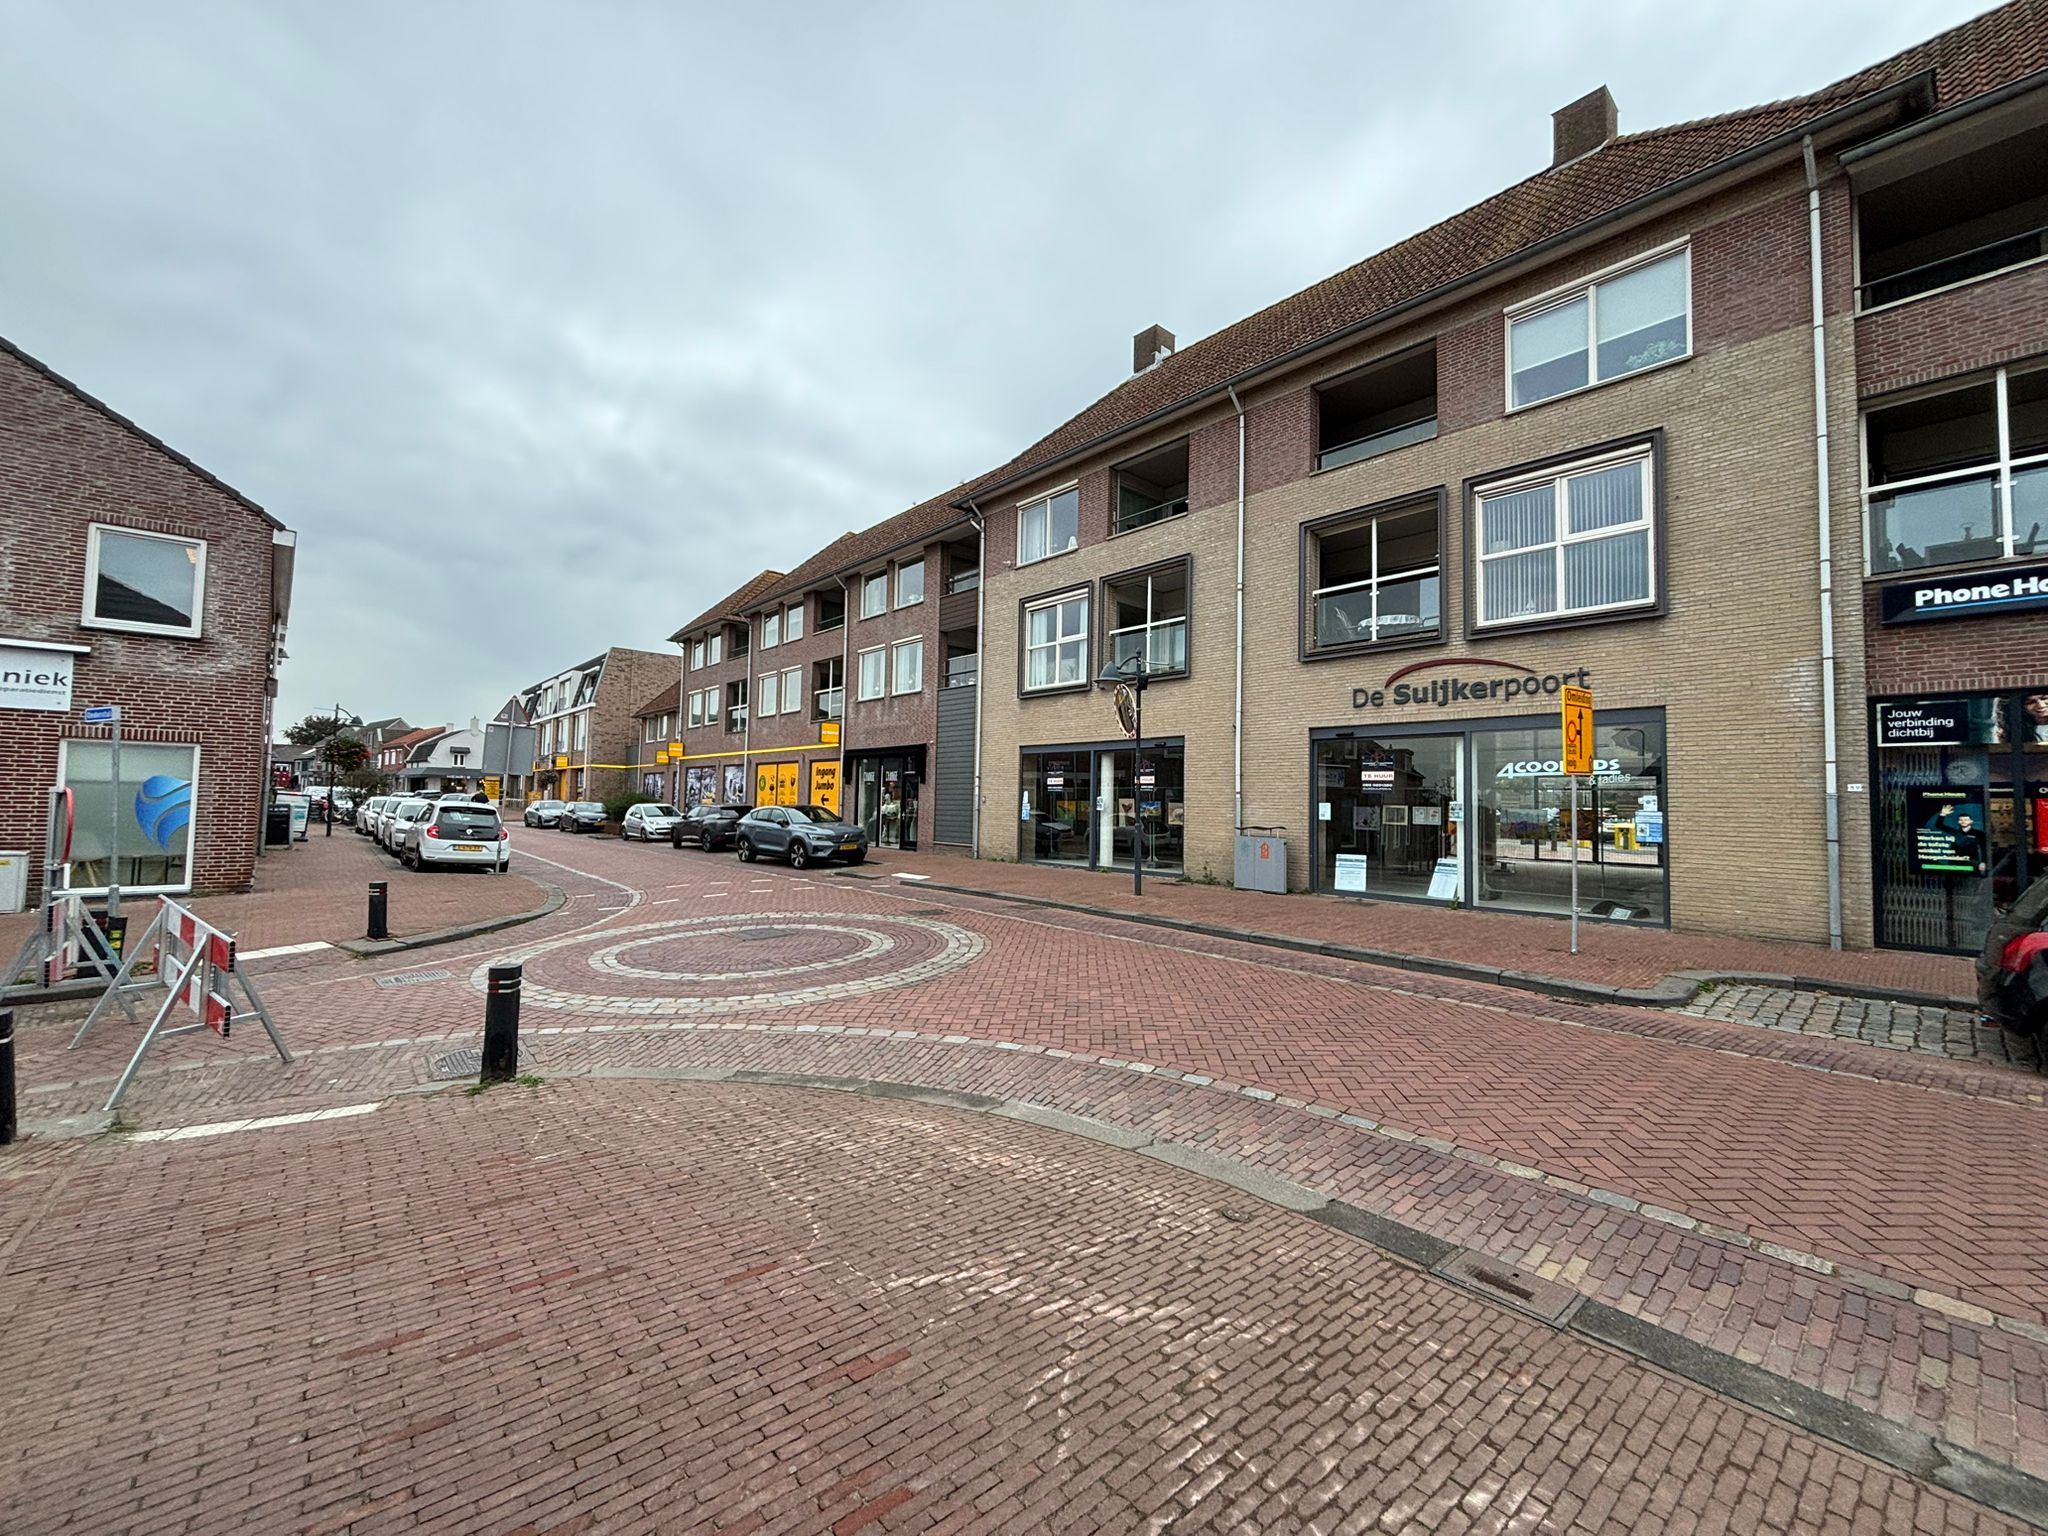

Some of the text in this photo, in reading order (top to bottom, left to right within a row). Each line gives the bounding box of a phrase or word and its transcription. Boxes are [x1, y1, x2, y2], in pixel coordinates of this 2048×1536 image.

[1915, 583, 2010, 607] Phone
[3, 670, 68, 687] niek
[1353, 666, 1591, 708] De Suijkerpoort
[1887, 710, 1923, 718] Jouw
[1887, 717, 1954, 728] verbinding
[1887, 727, 1934, 738] dichtbij
[815, 767, 836, 779] Ingang
[815, 780, 834, 790] Jumbo
